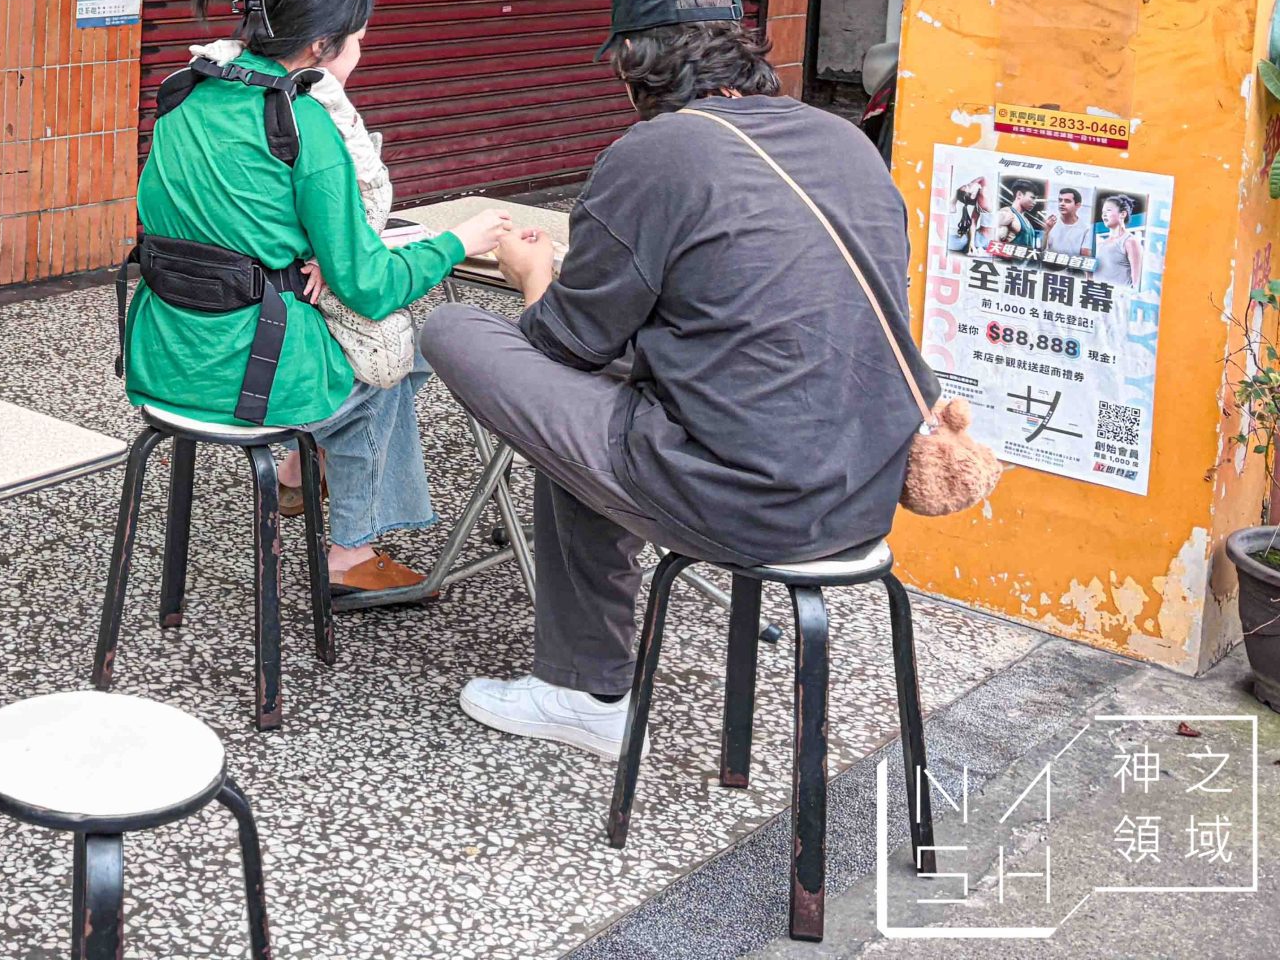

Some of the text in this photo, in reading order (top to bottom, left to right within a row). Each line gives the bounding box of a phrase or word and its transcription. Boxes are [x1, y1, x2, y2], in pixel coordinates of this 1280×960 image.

[1049, 116, 1127, 137] 2833-0466
[968, 259, 1115, 314] 全新開幕
[995, 302, 1026, 315] 1,000
[1029, 307, 1040, 319] 名
[958, 322, 979, 336] 送你
[987, 323, 1078, 357] $88,888
